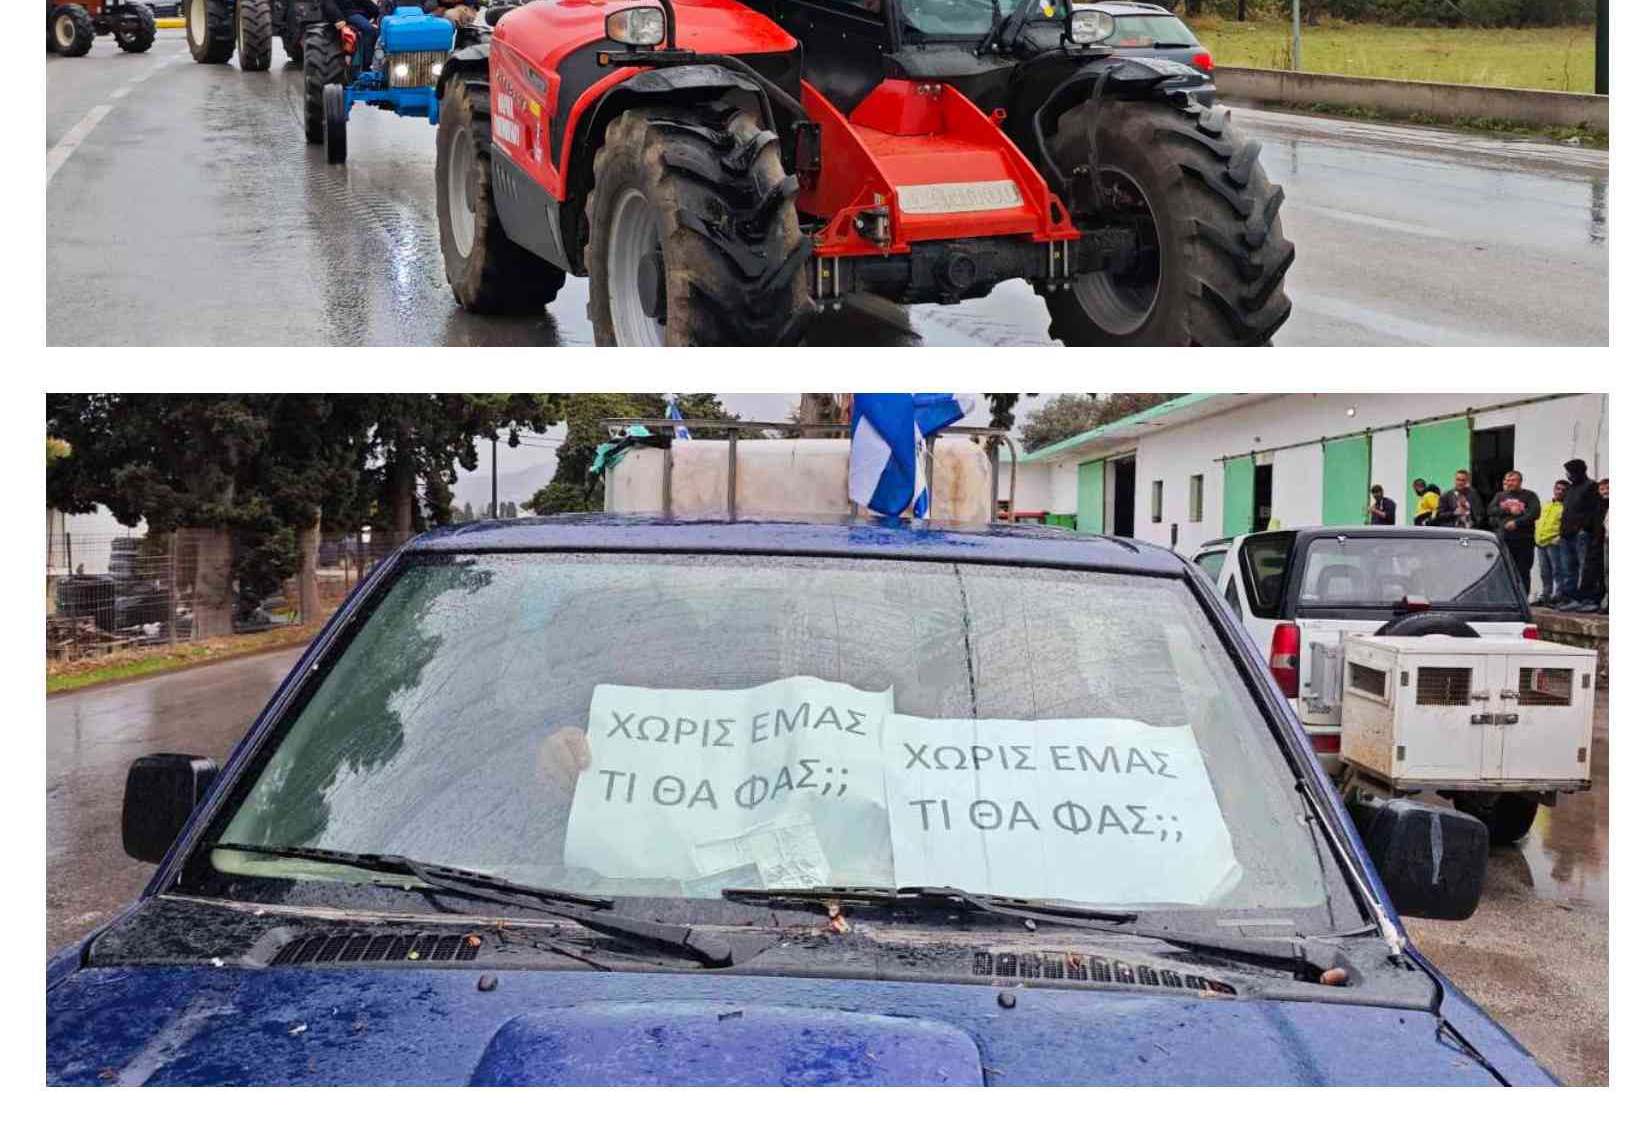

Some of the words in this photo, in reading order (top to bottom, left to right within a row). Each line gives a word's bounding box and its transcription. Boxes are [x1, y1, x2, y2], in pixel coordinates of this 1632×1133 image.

[606, 710, 737, 747] ΧΩΡΙΣ
[750, 701, 868, 745] ΕΜΑΣ
[903, 742, 1038, 771] ΧΩΡΙΣ
[1049, 745, 1178, 779] ΕΜΑΣ
[599, 769, 638, 804] ΤΙ
[652, 774, 719, 811] ΘΑ
[734, 758, 849, 811] ΦΑΣ;;
[908, 798, 952, 832] ΤΙ
[968, 799, 1041, 832] ΘΑ
[1052, 799, 1185, 843] ΦΑΣ;;
